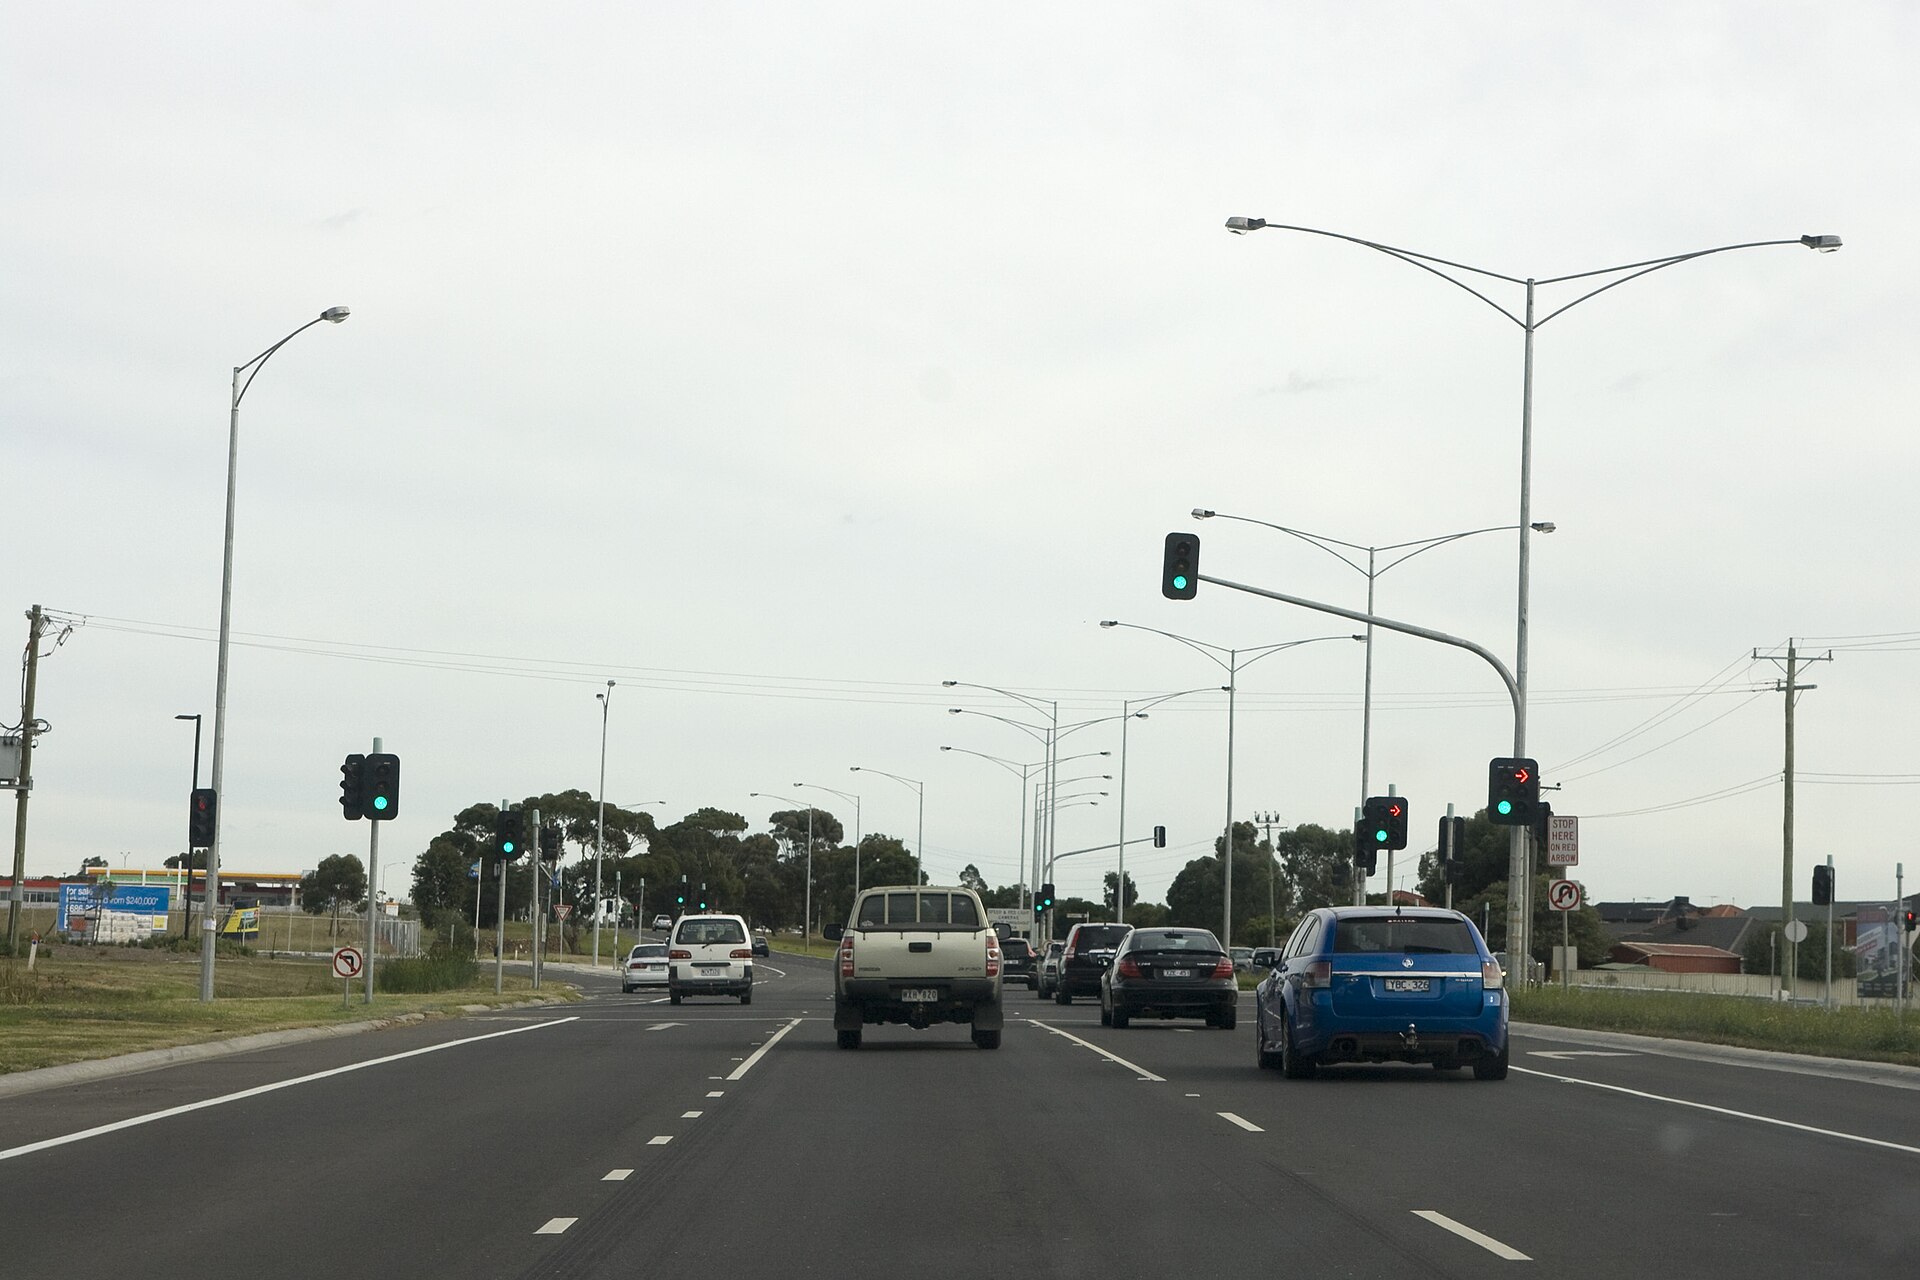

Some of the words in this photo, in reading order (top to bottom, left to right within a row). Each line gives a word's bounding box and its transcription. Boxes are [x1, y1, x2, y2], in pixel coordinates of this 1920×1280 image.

[1552, 819, 1574, 828] STOP
[1552, 831, 1575, 841] HERE
[1550, 843, 1560, 851] ON
[1562, 843, 1576, 851] RED
[1551, 854, 1576, 862] ARROW
